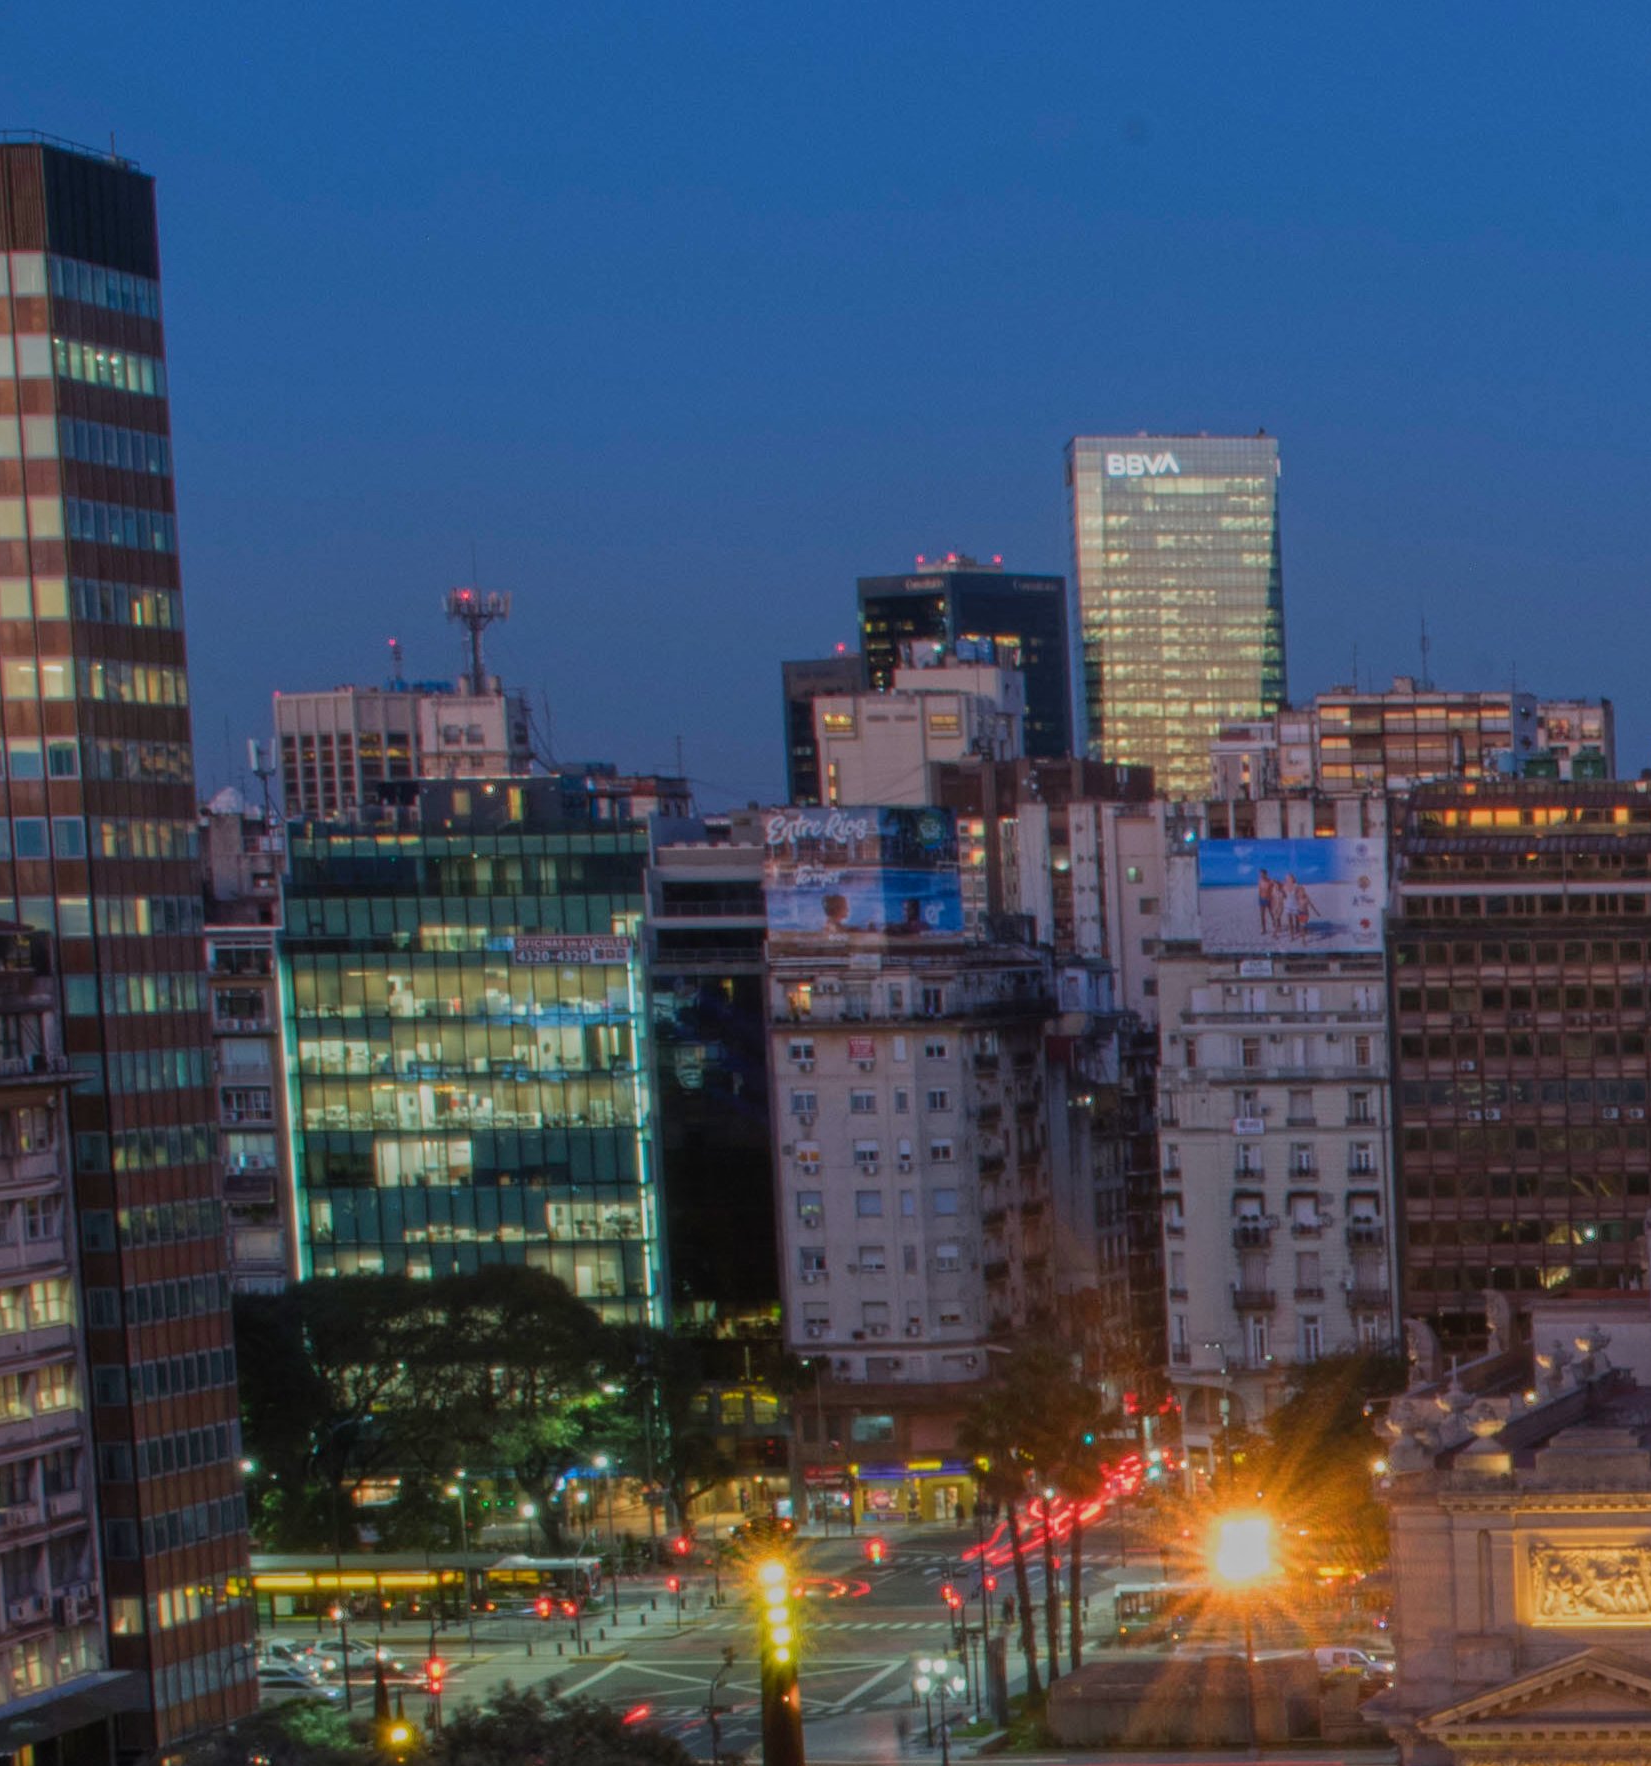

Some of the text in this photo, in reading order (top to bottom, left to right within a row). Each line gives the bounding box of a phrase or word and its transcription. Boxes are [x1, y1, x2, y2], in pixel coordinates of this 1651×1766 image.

[1108, 453, 1180, 476] BBVA
[767, 815, 822, 845] Entre
[516, 939, 564, 948] OFICINAS
[516, 950, 589, 961] 4320-4320
